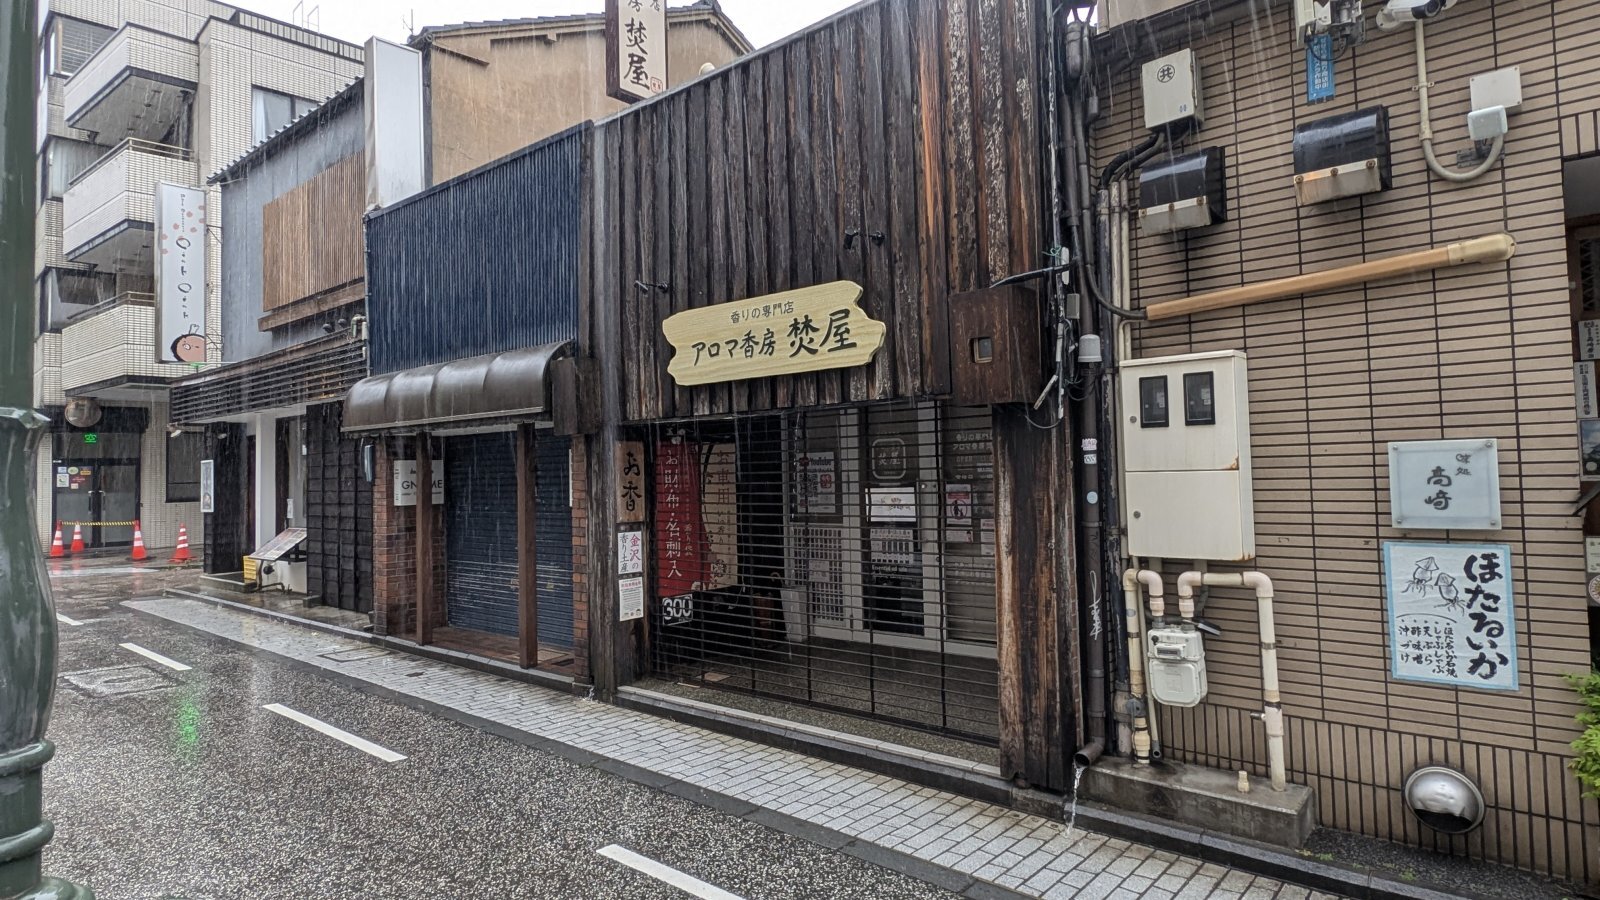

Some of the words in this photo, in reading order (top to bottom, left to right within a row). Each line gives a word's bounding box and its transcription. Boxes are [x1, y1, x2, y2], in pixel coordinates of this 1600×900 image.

[691, 328, 776, 366] アロマ香房
[787, 308, 858, 358] 焚屋
[730, 300, 795, 324] 香りの専門店
[621, 451, 642, 511] お香
[630, 534, 641, 569] 金沢の
[1464, 552, 1509, 680] ほたるいか
